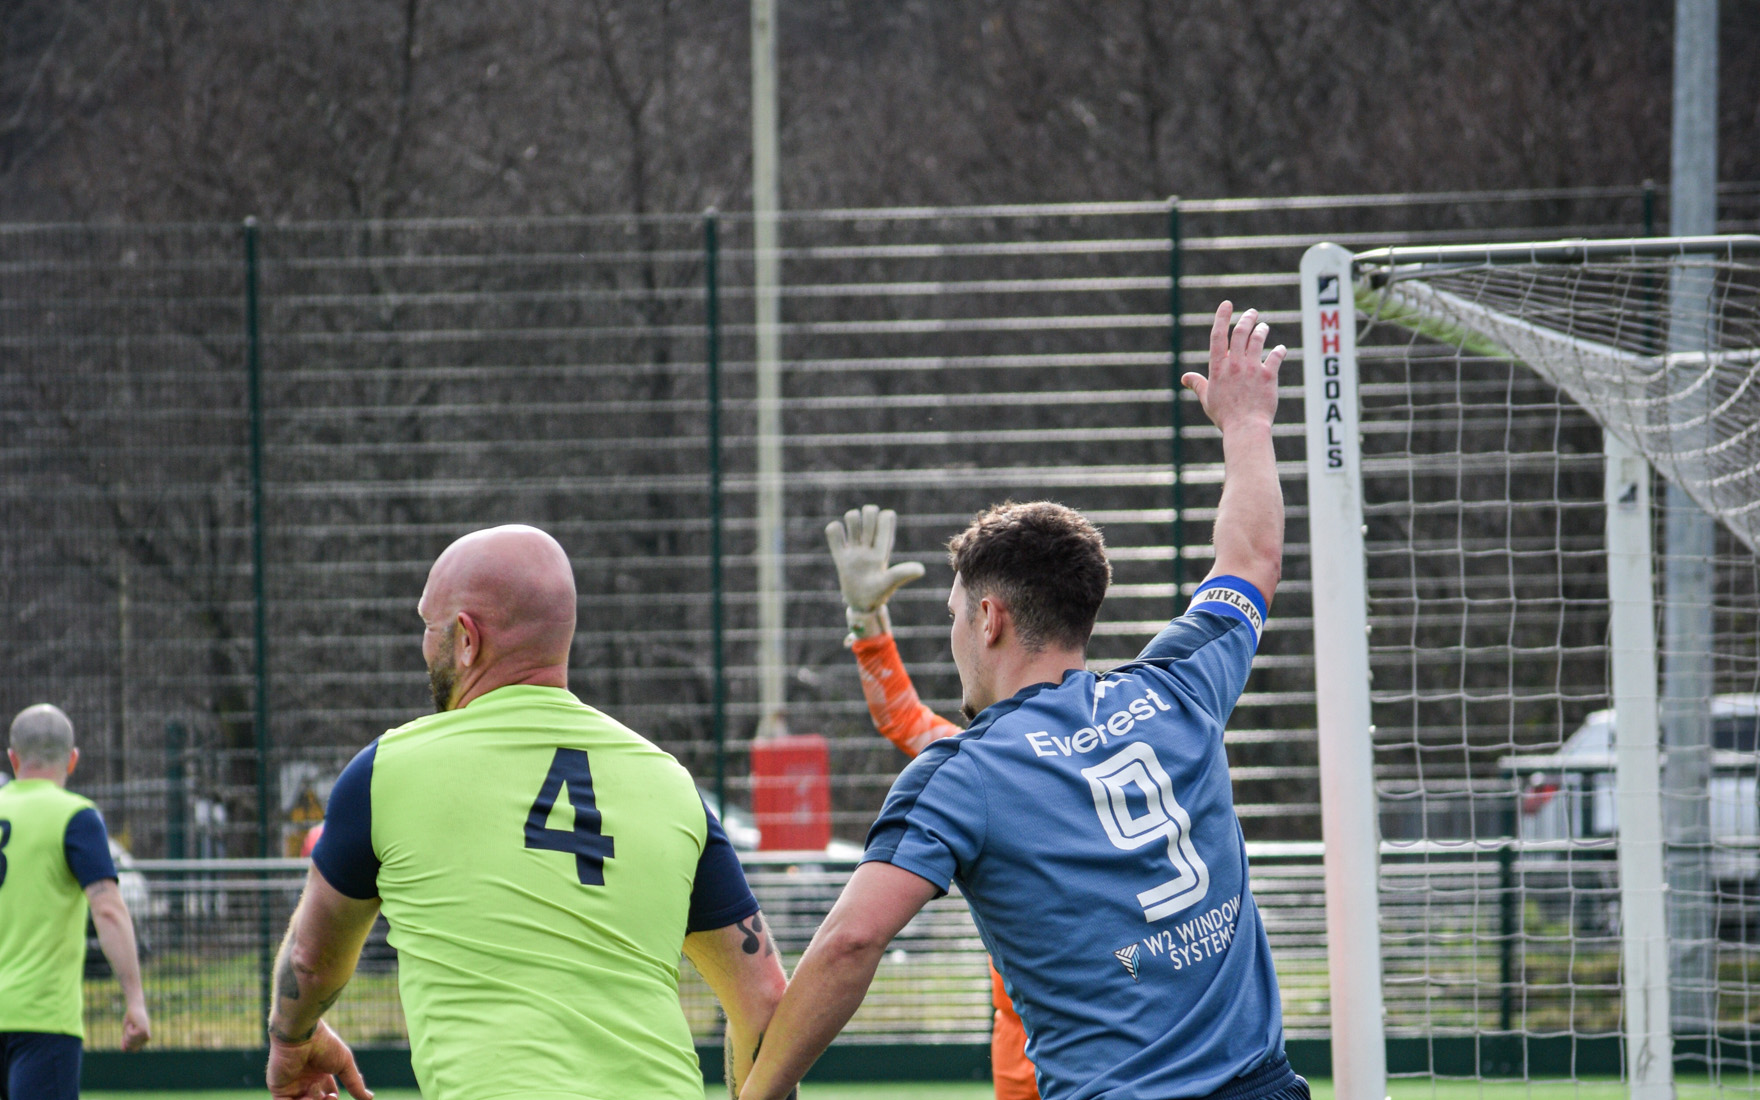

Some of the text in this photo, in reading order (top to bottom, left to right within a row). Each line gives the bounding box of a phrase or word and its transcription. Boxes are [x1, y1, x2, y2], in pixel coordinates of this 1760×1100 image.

[1204, 589, 1260, 630] CAPTAIN
[1024, 687, 1171, 758] Everest
[523, 746, 615, 887] 4
[1080, 741, 1210, 924] 9
[1143, 894, 1240, 957] W2 WINDOW
